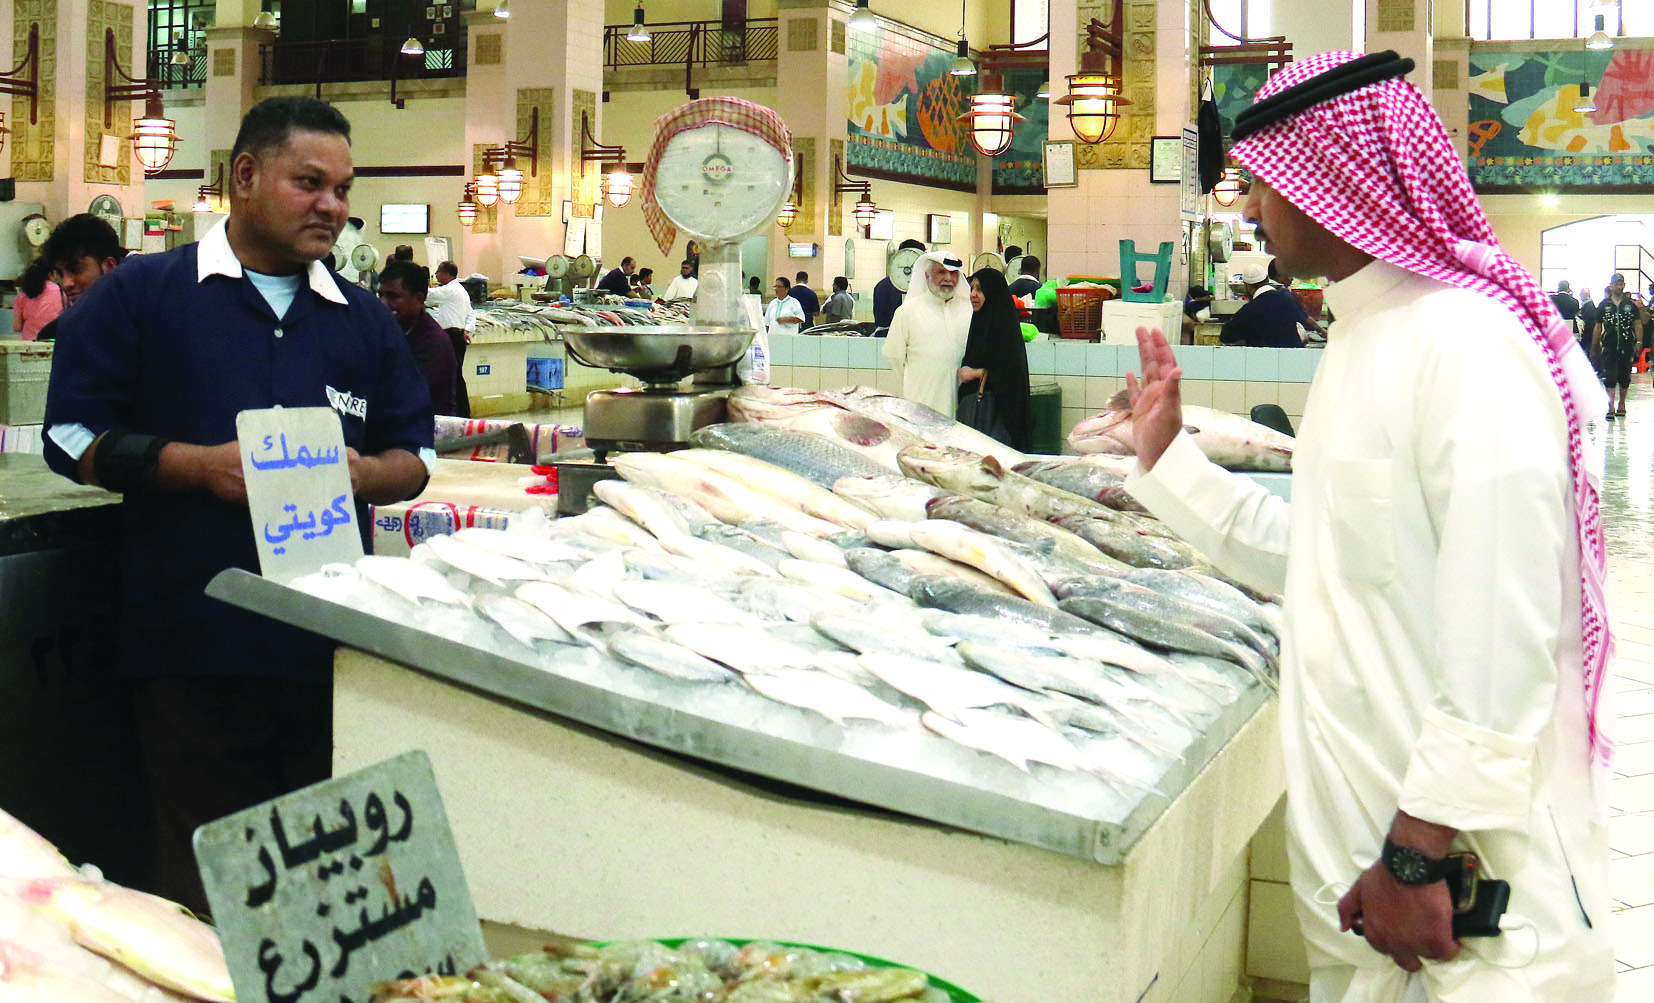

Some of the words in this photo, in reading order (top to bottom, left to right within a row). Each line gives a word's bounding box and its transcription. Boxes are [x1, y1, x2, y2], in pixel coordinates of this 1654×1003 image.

[251, 433, 339, 470] سمك
[264, 494, 351, 555] كويتي
[245, 790, 413, 908] روبيان
[258, 876, 436, 1003] مستزرع
